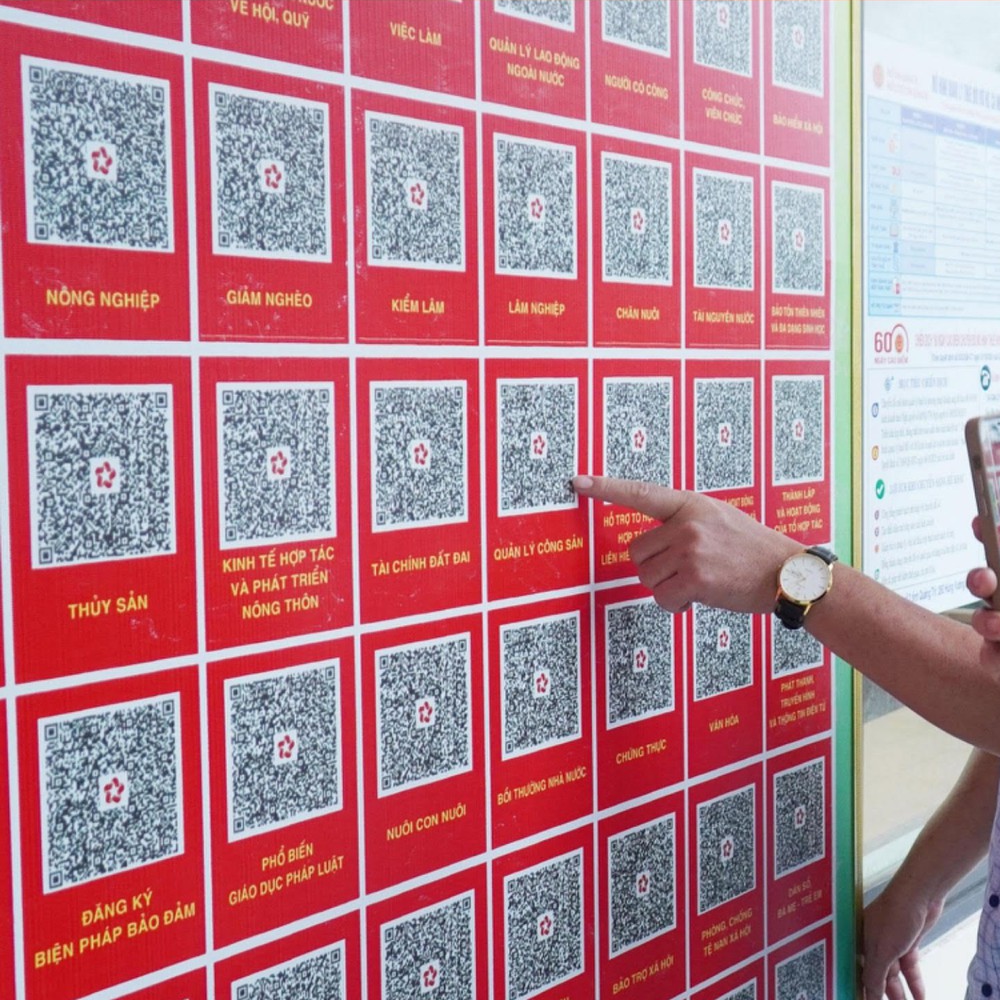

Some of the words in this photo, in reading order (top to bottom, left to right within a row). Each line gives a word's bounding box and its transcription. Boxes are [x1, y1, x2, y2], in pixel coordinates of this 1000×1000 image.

[282, 9, 310, 29] QUỸ
[389, 20, 416, 40] VIỆC
[418, 27, 442, 47] LÀM
[489, 36, 517, 56] QUẢN
[519, 43, 532, 58] LÝ
[533, 47, 552, 63] LAO
[553, 51, 580, 70] ĐỘNG
[506, 62, 537, 80] NGOÀI
[539, 69, 565, 86] NƯỚC
[604, 74, 632, 91] NGƯỜI
[632, 80, 645, 95] CÓ
[645, 82, 669, 100] CÔNG
[46, 286, 96, 307] NÔNG
[99, 289, 160, 312] NGHIỆP
[226, 285, 262, 306] GIẢM
[265, 289, 313, 309] NGHÈO
[391, 293, 419, 313] KIỂM
[421, 297, 445, 315] LÂM
[508, 298, 529, 315] LÂM
[530, 300, 566, 318] NGHIỆP
[616, 304, 639, 320] CHĂN
[640, 306, 660, 321] NUÔI
[693, 309, 705, 322] TÀI
[705, 310, 734, 324] NGUYÊN
[735, 310, 755, 324] NƯỚC
[874, 331, 892, 352] 60
[222, 556, 255, 573] KINH
[259, 548, 276, 568] TẾ
[279, 549, 307, 566] HỢP
[309, 546, 335, 561] TÁC
[493, 542, 521, 561] QUẢN
[523, 541, 536, 556] LÝ
[537, 538, 564, 554] CÔNG
[565, 533, 584, 551] SẢN
[371, 559, 390, 577] TÀI
[392, 555, 427, 573] CHÍNH
[429, 549, 451, 568] ĐẤT
[452, 551, 471, 564] ĐAI
[230, 577, 249, 597] VÀ
[252, 574, 288, 594] PHÁT
[291, 564, 329, 588] TRIỂN
[68, 594, 111, 619] THỦY
[116, 590, 148, 613] SẢN
[242, 599, 281, 620] NÔNG
[284, 593, 319, 612] THÔN
[709, 718, 724, 732] VĂN
[724, 714, 739, 728] HÓA
[615, 745, 645, 764] CHỨNG
[645, 739, 667, 756] THỰC
[497, 786, 512, 805] BỒI
[514, 779, 546, 800] THƯỜNG
[548, 771, 565, 788] NHÀ
[565, 766, 588, 783] NƯỚC
[386, 819, 413, 841] NUÔI
[416, 813, 439, 831] CON
[441, 802, 467, 823] NUÔI
[261, 849, 286, 872] PHỔ
[288, 840, 313, 862] BIẾN
[228, 884, 257, 906] GIÁO
[260, 877, 284, 897] DỤC
[285, 866, 316, 887] PHÁP
[317, 855, 345, 877] LUẬT
[81, 898, 128, 927] ĐĂNG
[131, 888, 153, 910] KÝ
[34, 942, 74, 969] BIỆN
[79, 925, 123, 954] PHÁP
[127, 912, 160, 938] BẢO
[163, 901, 196, 925] ĐẢM
[612, 976, 630, 995] BẢO
[631, 967, 648, 984] TRỢ
[649, 961, 659, 976] XÃ
[660, 954, 674, 970] HỘI
